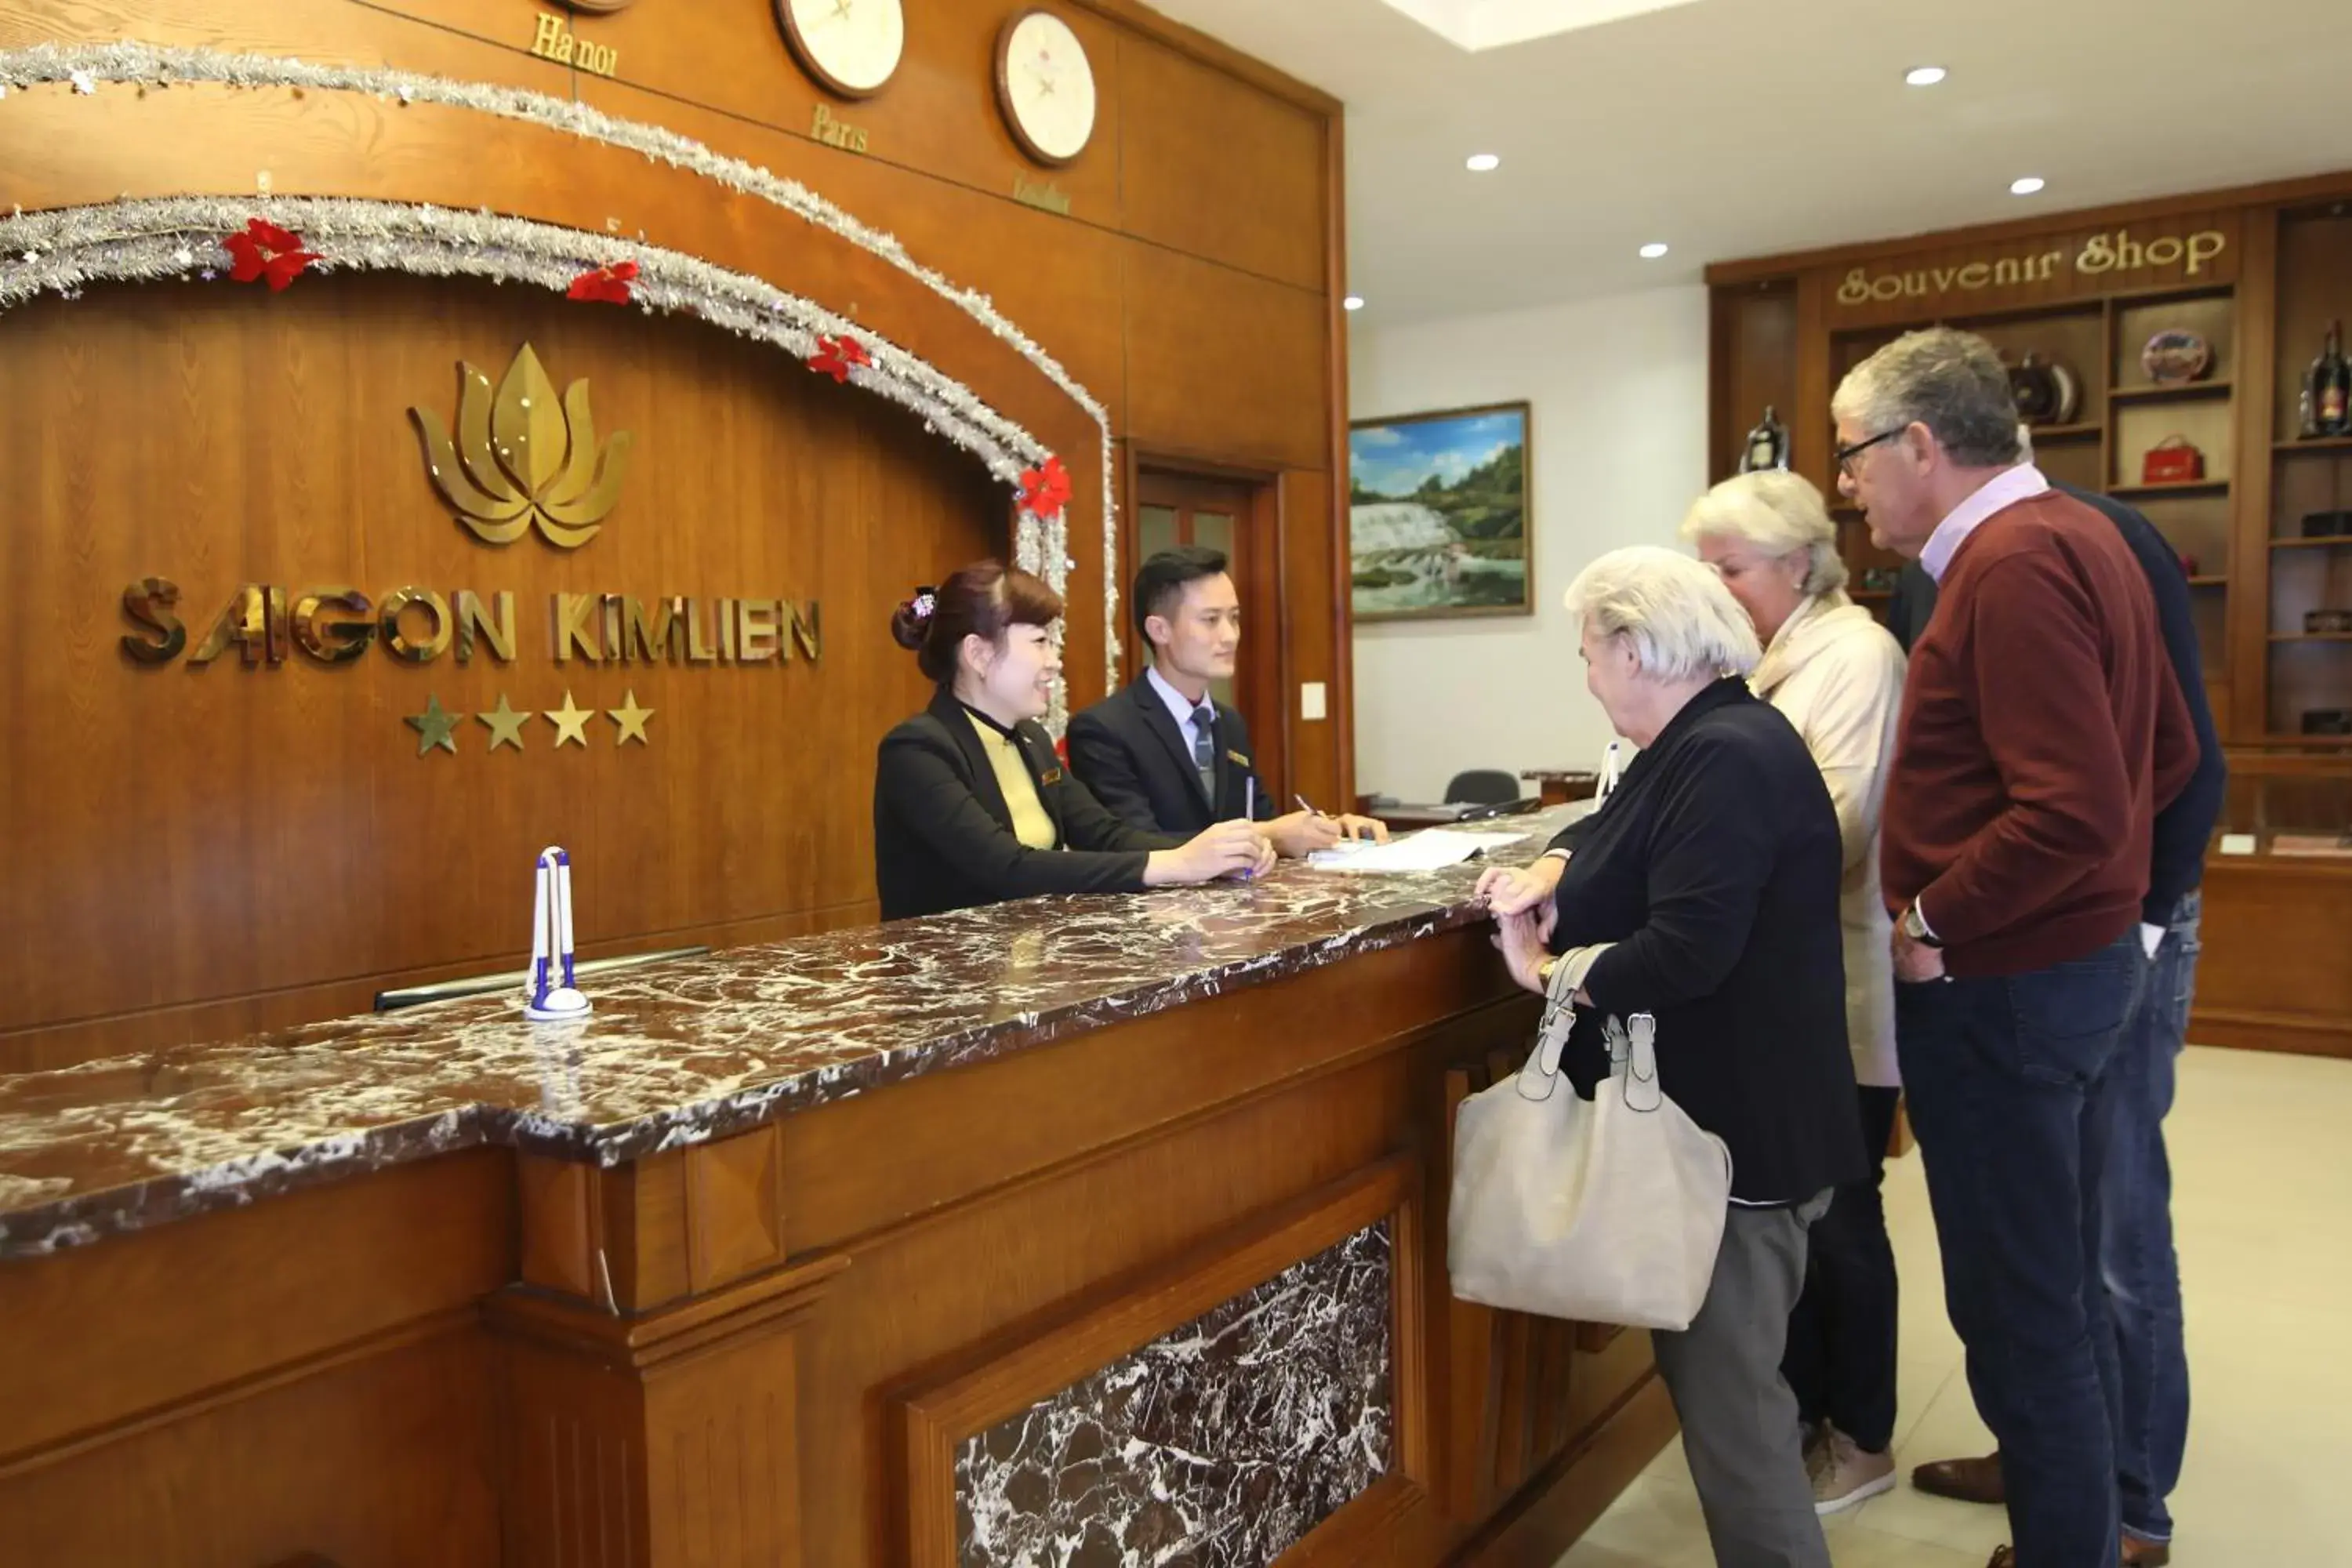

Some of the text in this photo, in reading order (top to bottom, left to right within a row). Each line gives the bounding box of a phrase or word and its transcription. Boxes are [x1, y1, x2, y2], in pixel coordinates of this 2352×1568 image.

[531, 12, 618, 78] Hanoi
[811, 102, 869, 153] Paris
[1836, 230, 2226, 305] Souvenir Shop
[120, 576, 821, 665] SAIGON KIMLIEN
